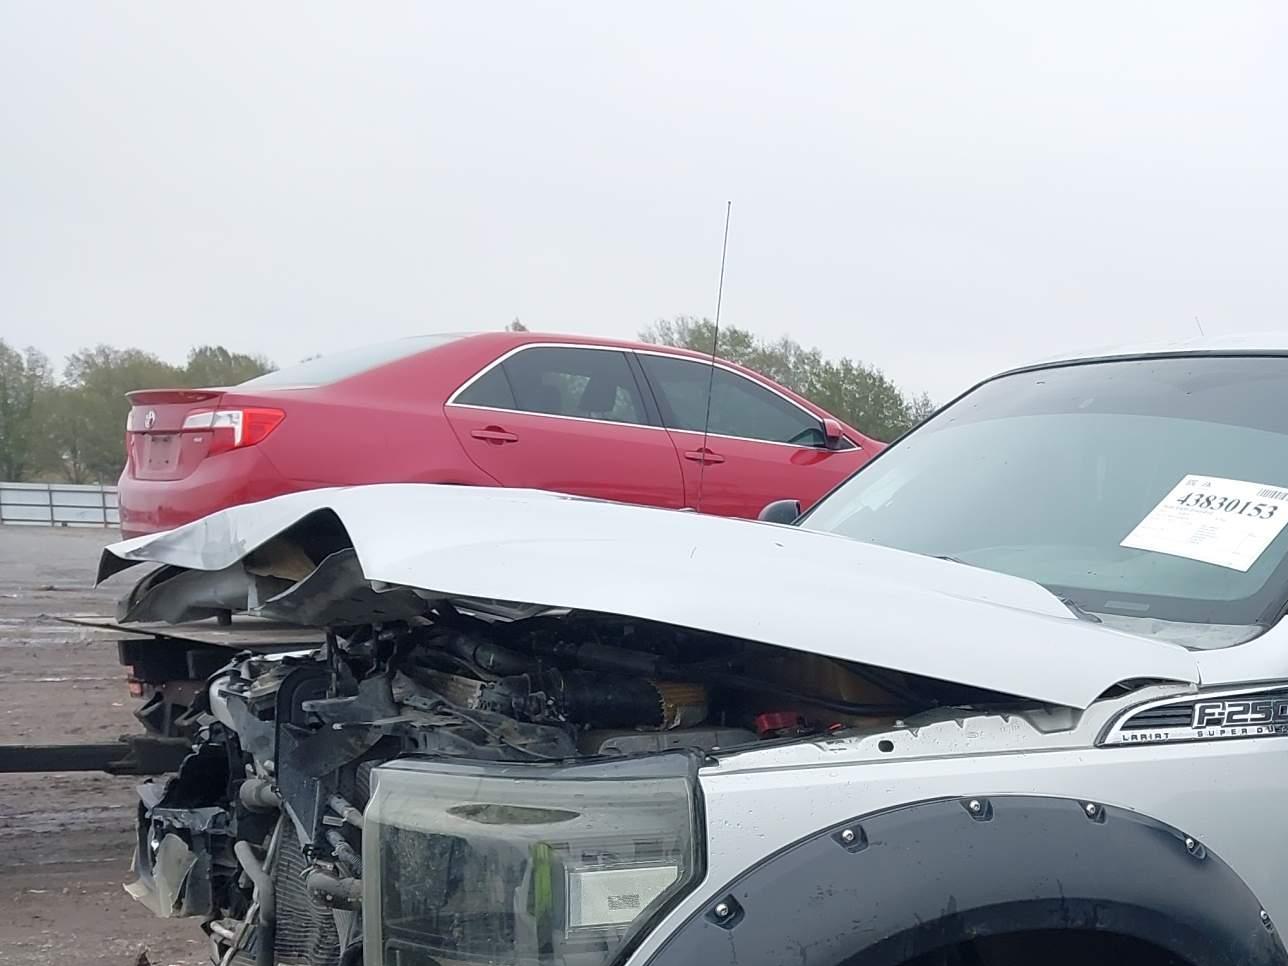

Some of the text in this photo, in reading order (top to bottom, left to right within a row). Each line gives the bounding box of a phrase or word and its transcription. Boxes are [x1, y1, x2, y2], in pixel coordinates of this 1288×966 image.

[1176, 491, 1279, 520] 43830153
[1122, 732, 1170, 742] LARIAT
[1197, 727, 1248, 738] SUPER
